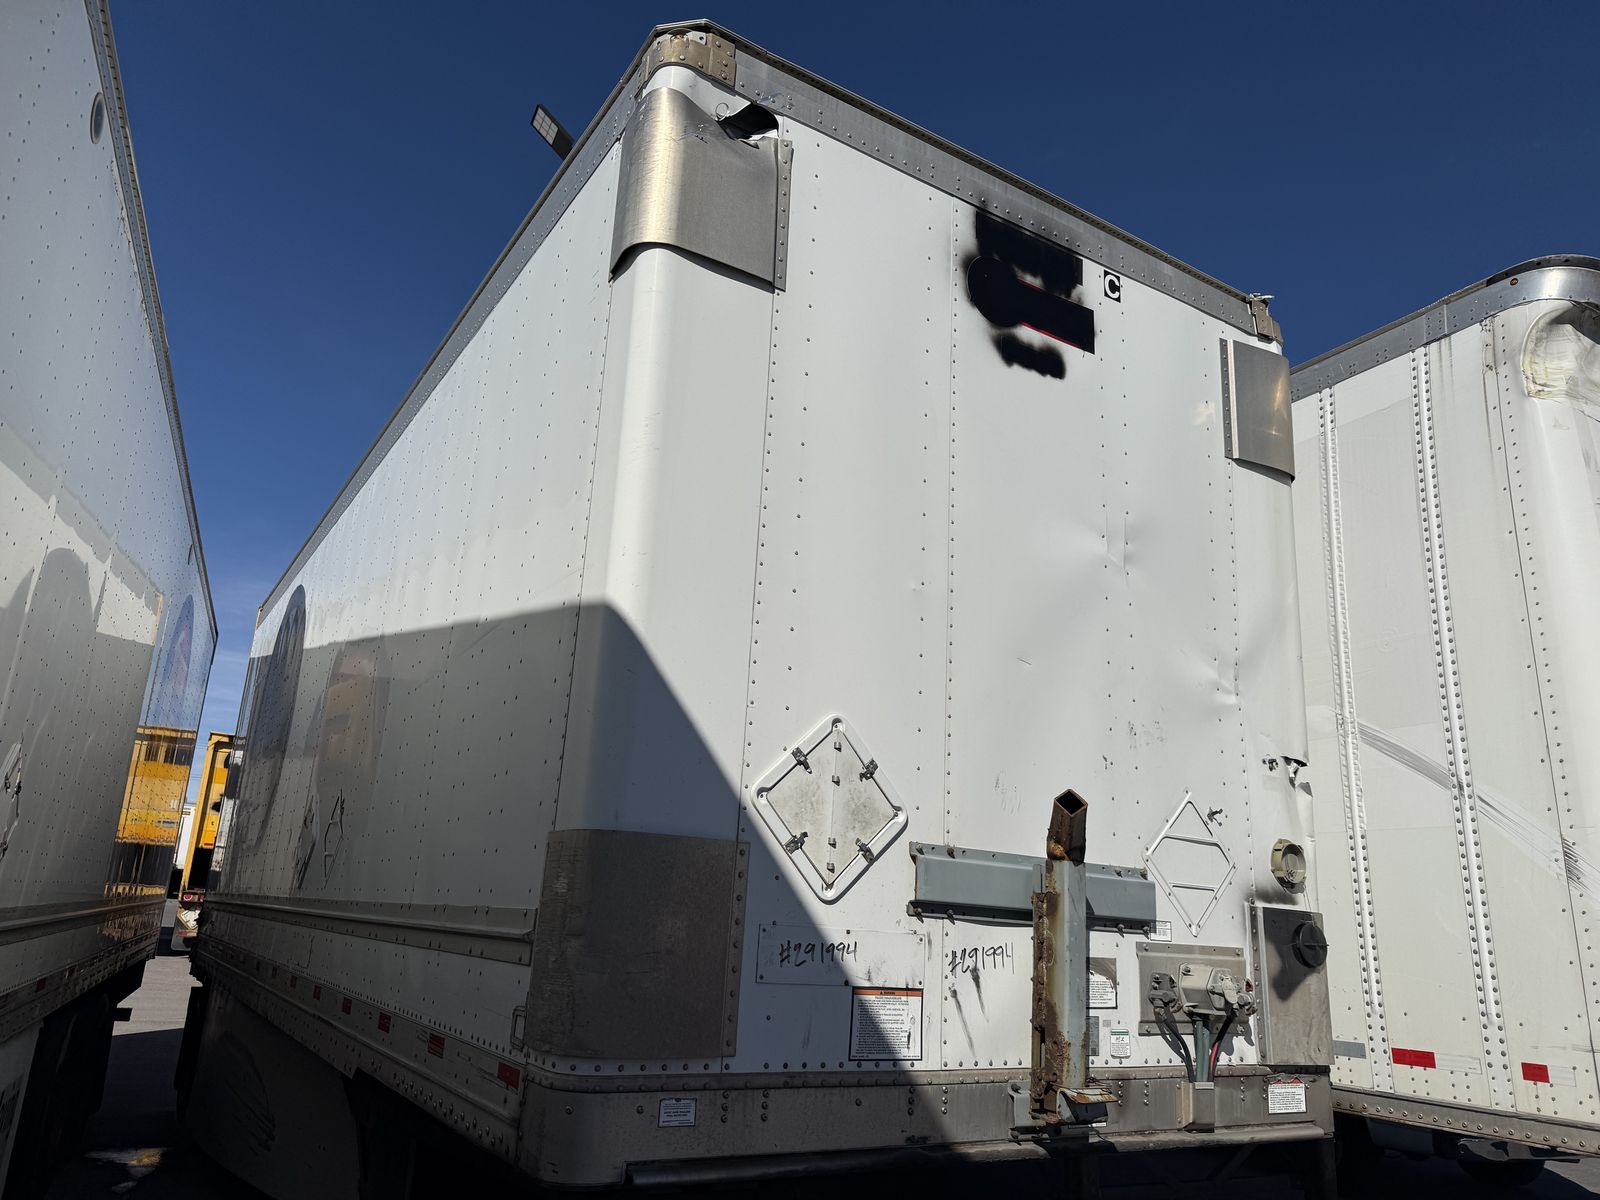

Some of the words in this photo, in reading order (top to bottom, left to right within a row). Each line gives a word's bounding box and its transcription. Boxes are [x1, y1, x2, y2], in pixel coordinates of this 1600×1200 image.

[1104, 274, 1120, 299] C
[779, 940, 857, 968] #291994
[948, 942, 1015, 978] #291994
